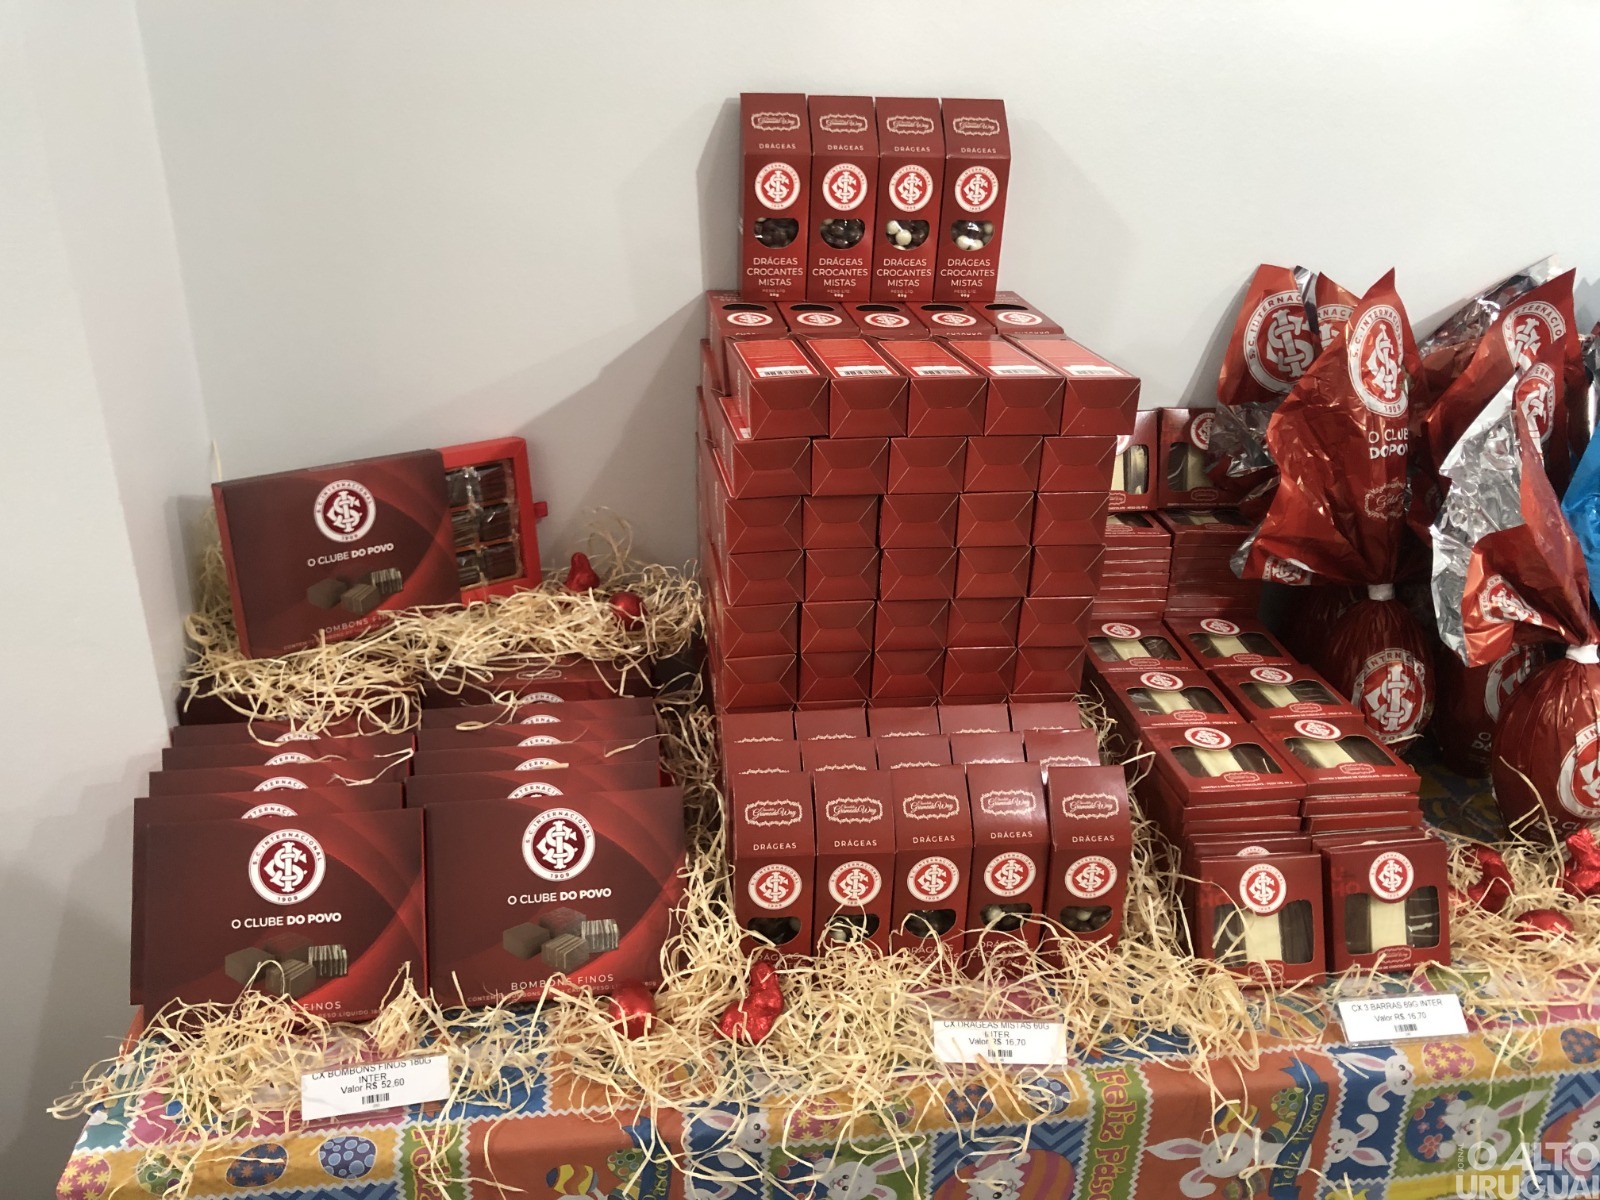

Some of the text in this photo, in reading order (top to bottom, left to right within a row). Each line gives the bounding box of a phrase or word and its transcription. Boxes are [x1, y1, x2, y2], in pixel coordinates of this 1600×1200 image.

[753, 256, 798, 266] DRÁGEAS
[819, 256, 863, 266] DRÁGEAS
[883, 256, 927, 267] DRÁGEAS
[947, 256, 990, 268] DRÁGEAS
[746, 267, 804, 276] CROCANTES
[812, 268, 868, 277] CROCANTES
[876, 268, 932, 278] CROCANTES
[940, 268, 995, 278] CROCANTES
[758, 278, 792, 286] MISTAS
[823, 278, 856, 287] MISTAS
[887, 278, 920, 287] MISTAS
[950, 278, 982, 287] MISTAS
[1368, 428, 1409, 444] O CLUB
[308, 542, 394, 567] O CLUBE DO POVO
[319, 617, 369, 634] OMBONS
[533, 811, 592, 840] INTERNACIONAL
[912, 835, 956, 844] DRÁGEAS
[990, 831, 1033, 839] DRÁGEAS
[1072, 834, 1115, 843] DRÁGEAS
[262, 832, 323, 862] INTERNACIONAL
[753, 842, 797, 850] DRÁGEAS
[834, 840, 878, 848] DRÁGEAS
[508, 887, 612, 906] O CLUBE DO POVO
[230, 912, 342, 930] O CLUBE DO POVO
[578, 973, 615, 984] FINOS
[1351, 1004, 1363, 1012] CX
[1364, 1004, 1370, 1012] 3
[1370, 1002, 1402, 1011] BARRAS
[1420, 998, 1444, 1007] INTER
[1374, 1014, 1393, 1022] Valor
[358, 1072, 387, 1084] INTER
[340, 1085, 363, 1094] Valor
[366, 1082, 378, 1091] R$
